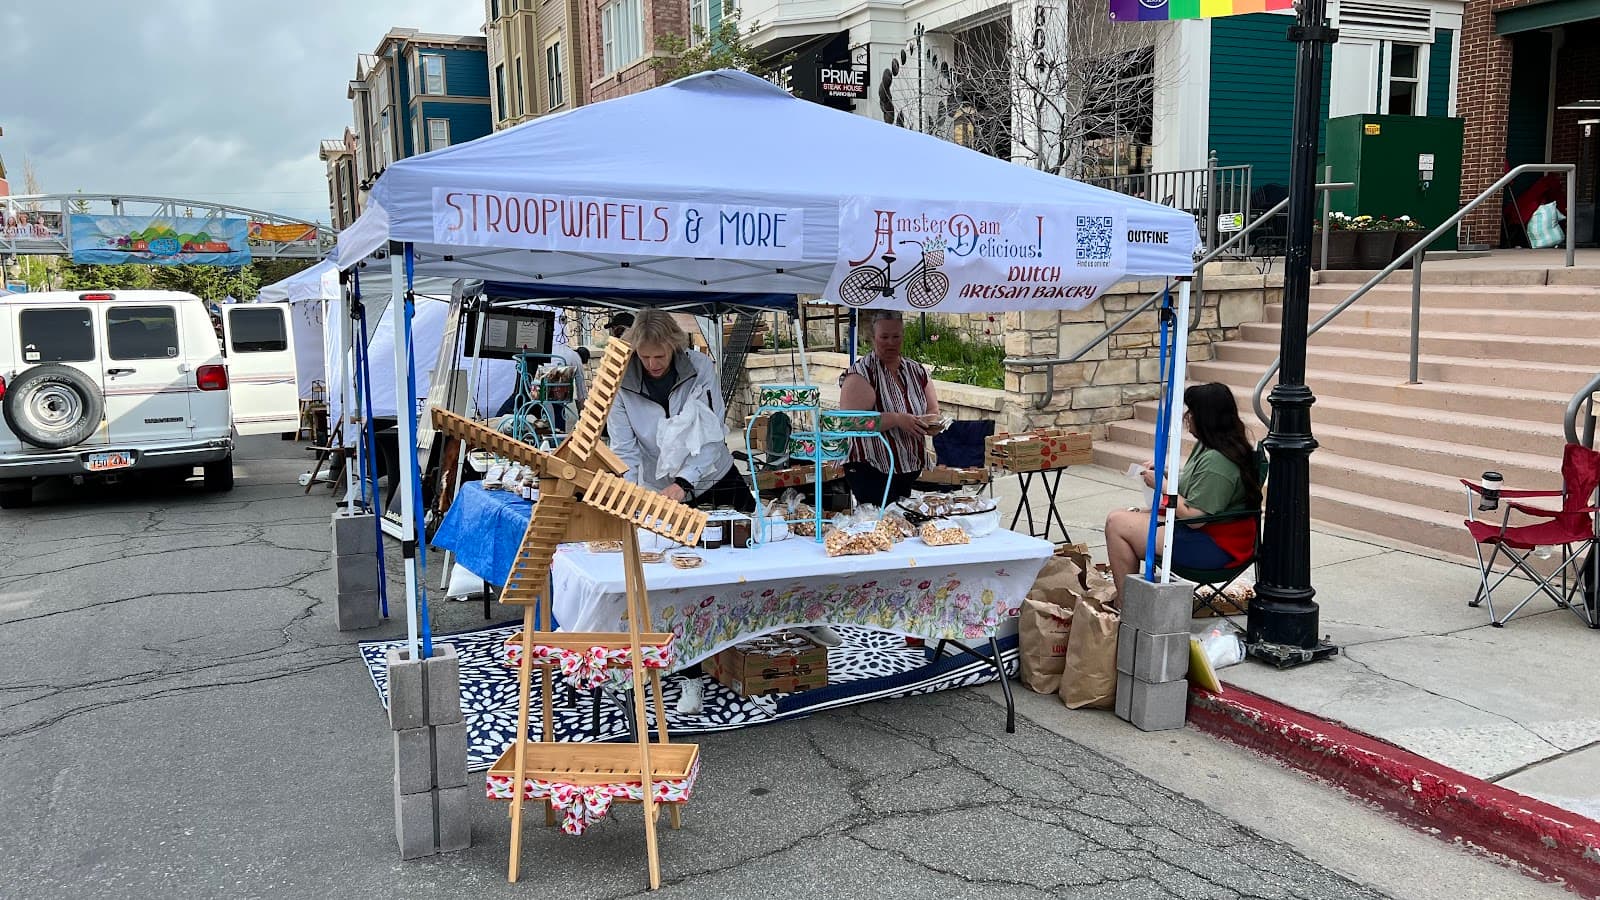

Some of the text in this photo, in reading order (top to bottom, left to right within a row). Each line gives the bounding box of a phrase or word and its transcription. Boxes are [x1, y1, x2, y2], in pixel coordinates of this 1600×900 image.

[821, 69, 864, 85] PRIME
[823, 83, 842, 91] STEAK
[446, 193, 788, 248] STROOPWAFELS & MORE
[1127, 230, 1169, 244] OUTFINE
